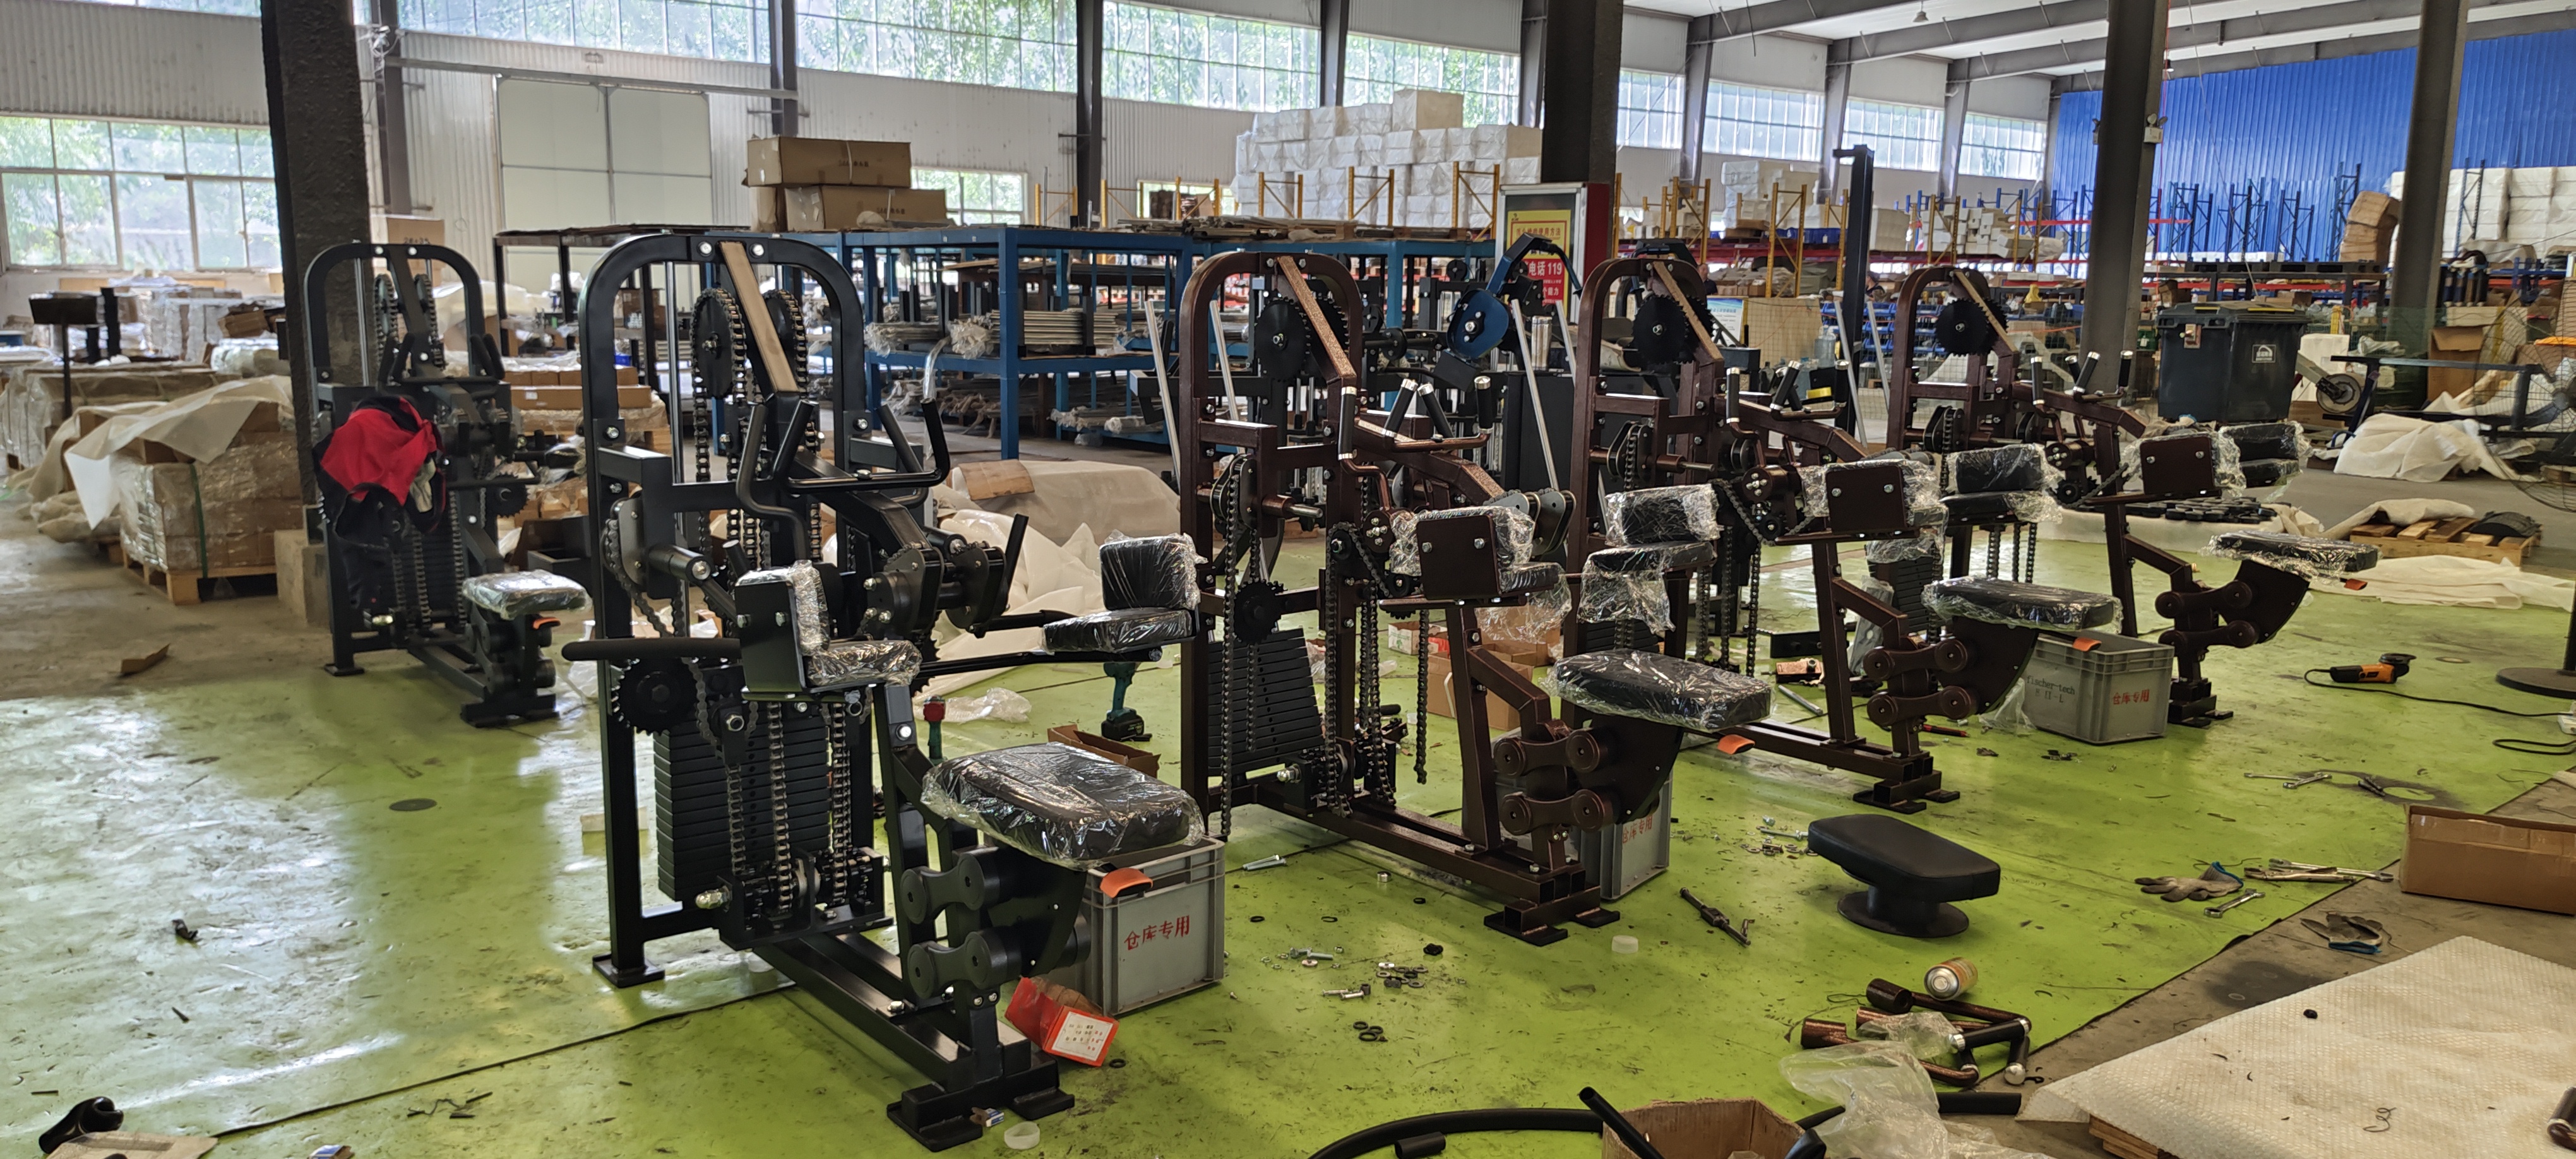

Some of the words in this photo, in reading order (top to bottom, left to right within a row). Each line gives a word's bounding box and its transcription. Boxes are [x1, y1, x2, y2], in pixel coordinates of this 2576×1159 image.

[1547, 263, 1562, 275] 119
[2027, 675, 2075, 695] fischer-tech
[2112, 689, 2150, 704] 仓库专用
[1623, 814, 1652, 843] 仓库专用
[1124, 915, 1190, 951] 仓库专用
